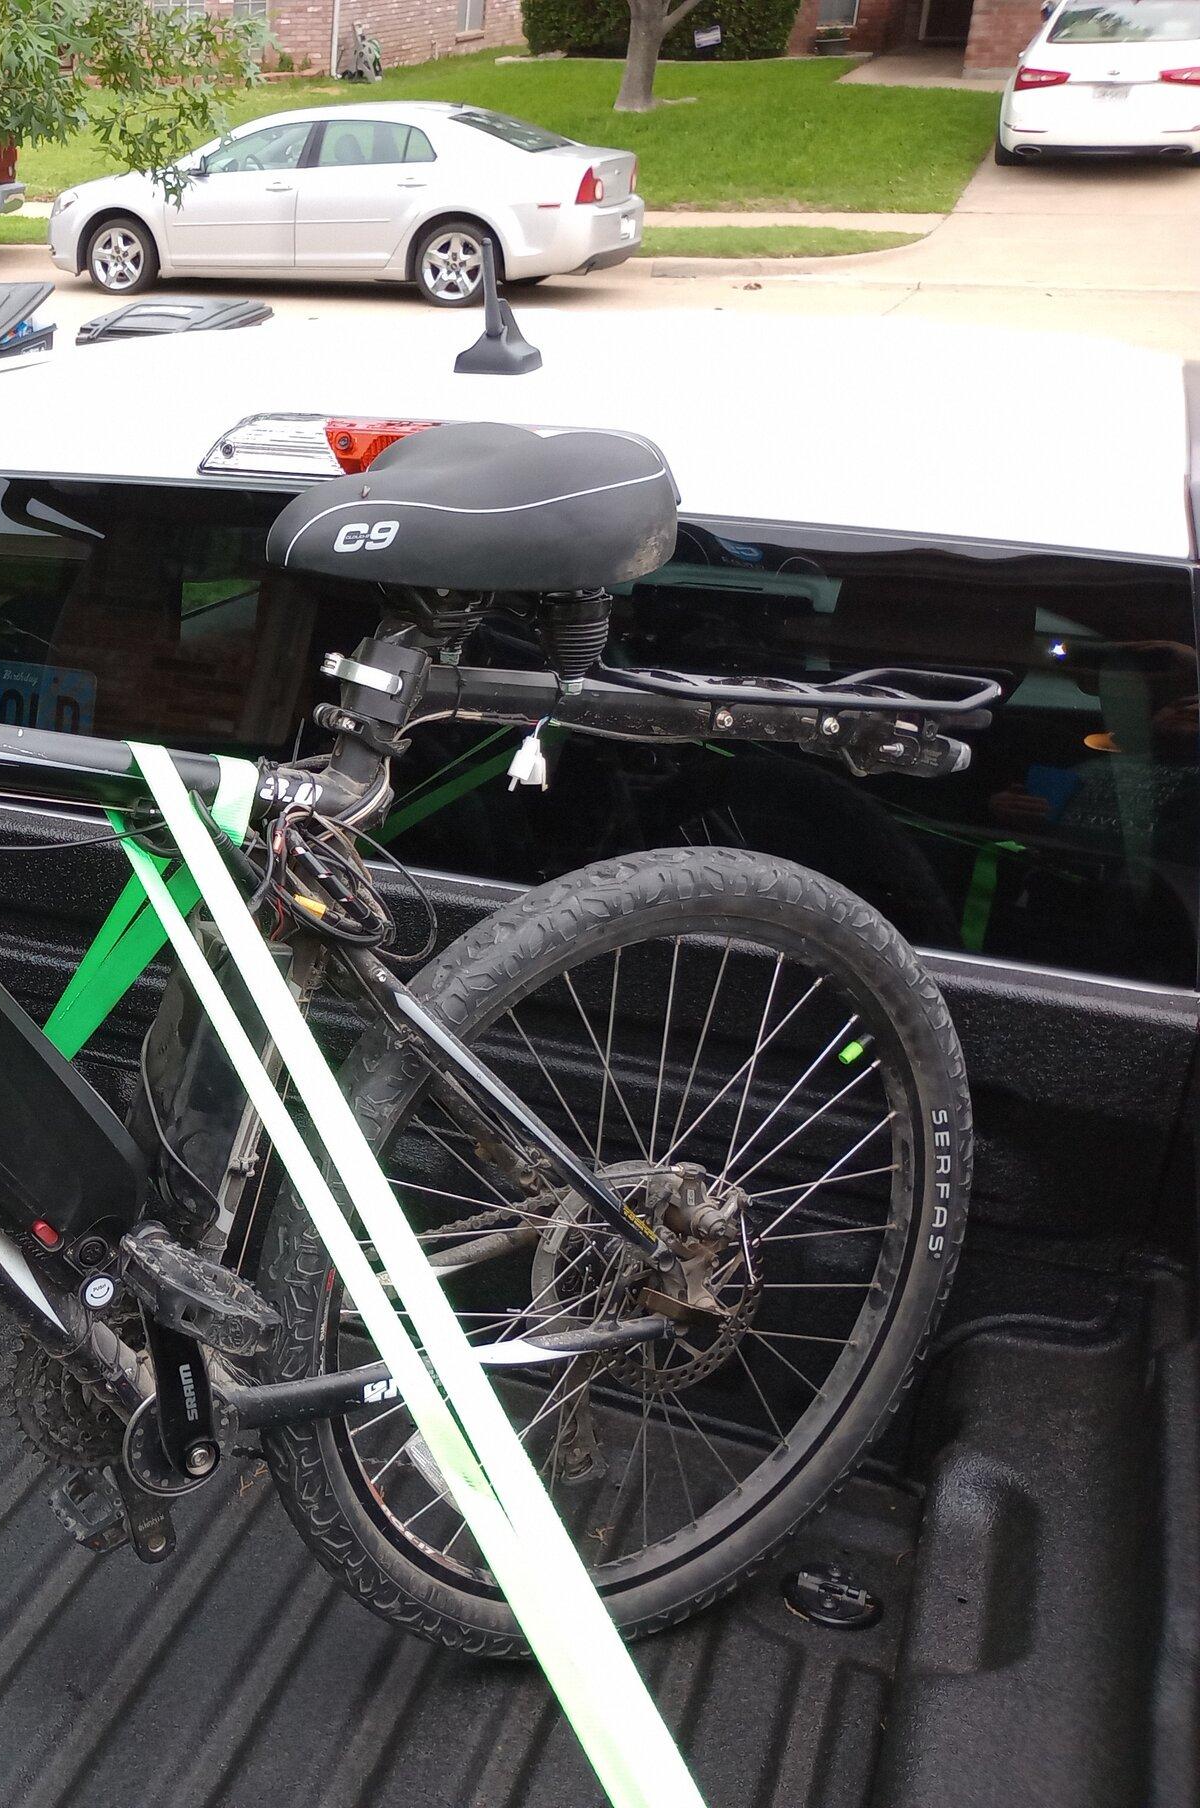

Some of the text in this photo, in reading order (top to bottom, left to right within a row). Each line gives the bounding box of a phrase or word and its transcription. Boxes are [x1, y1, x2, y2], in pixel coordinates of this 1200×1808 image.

[333, 520, 400, 553] C9
[2, 669, 39, 687] Birthday
[259, 777, 324, 806] 3.0
[92, 1283, 107, 1293] PUSH
[178, 1363, 199, 1422] SRAM
